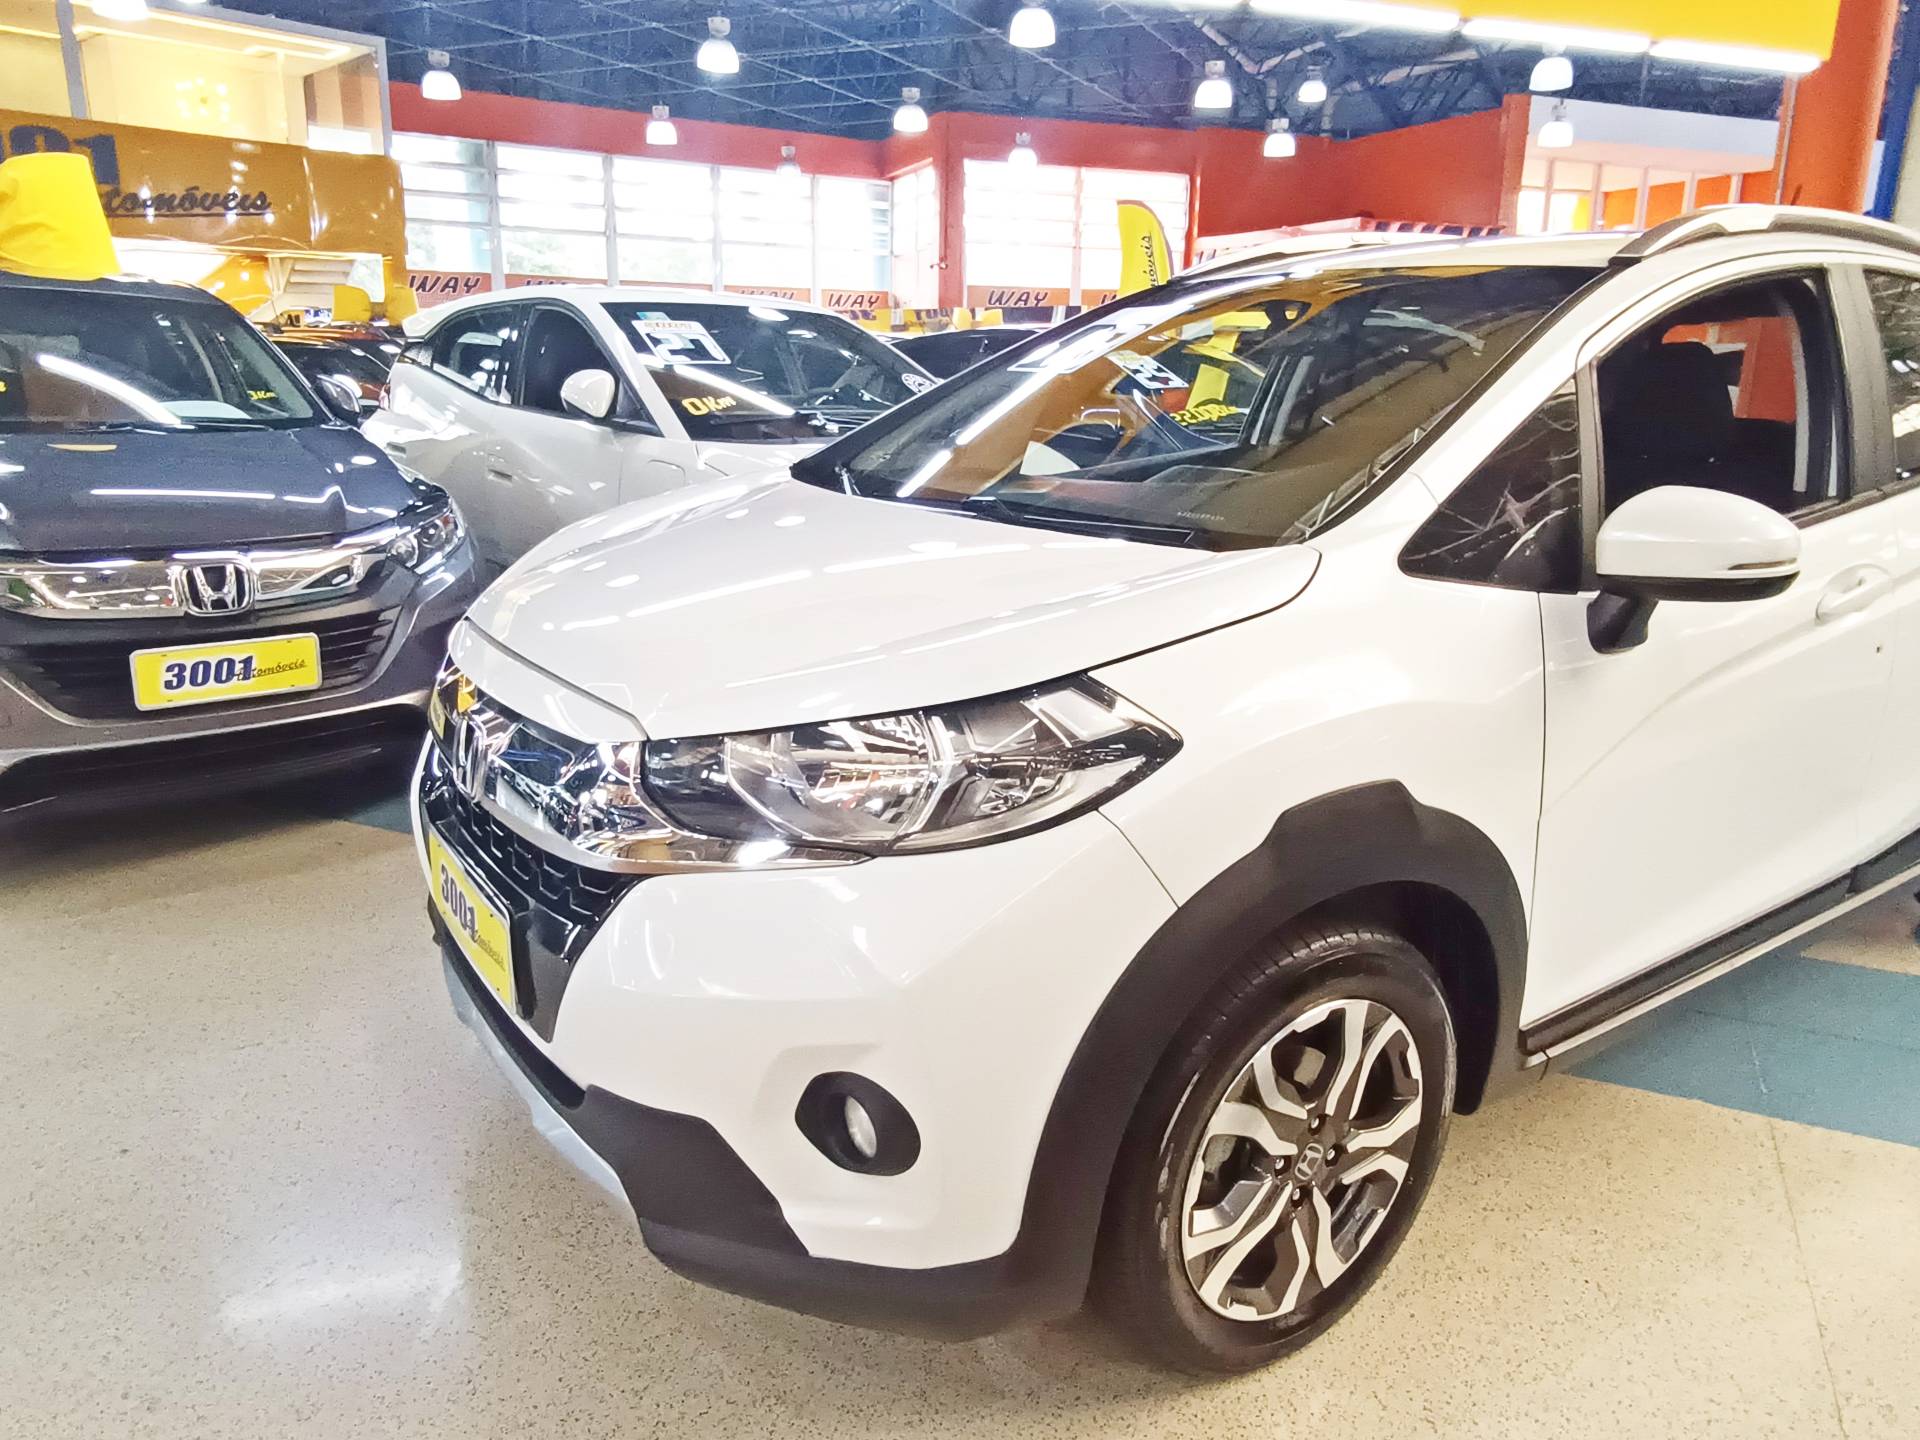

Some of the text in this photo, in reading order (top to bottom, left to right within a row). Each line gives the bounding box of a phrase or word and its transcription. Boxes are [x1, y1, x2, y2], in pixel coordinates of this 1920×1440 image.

[409, 275, 480, 294] WAY
[827, 293, 880, 308] WAY
[988, 290, 1048, 307] WAY
[164, 656, 253, 690] 3001
[441, 864, 476, 942] 3001
